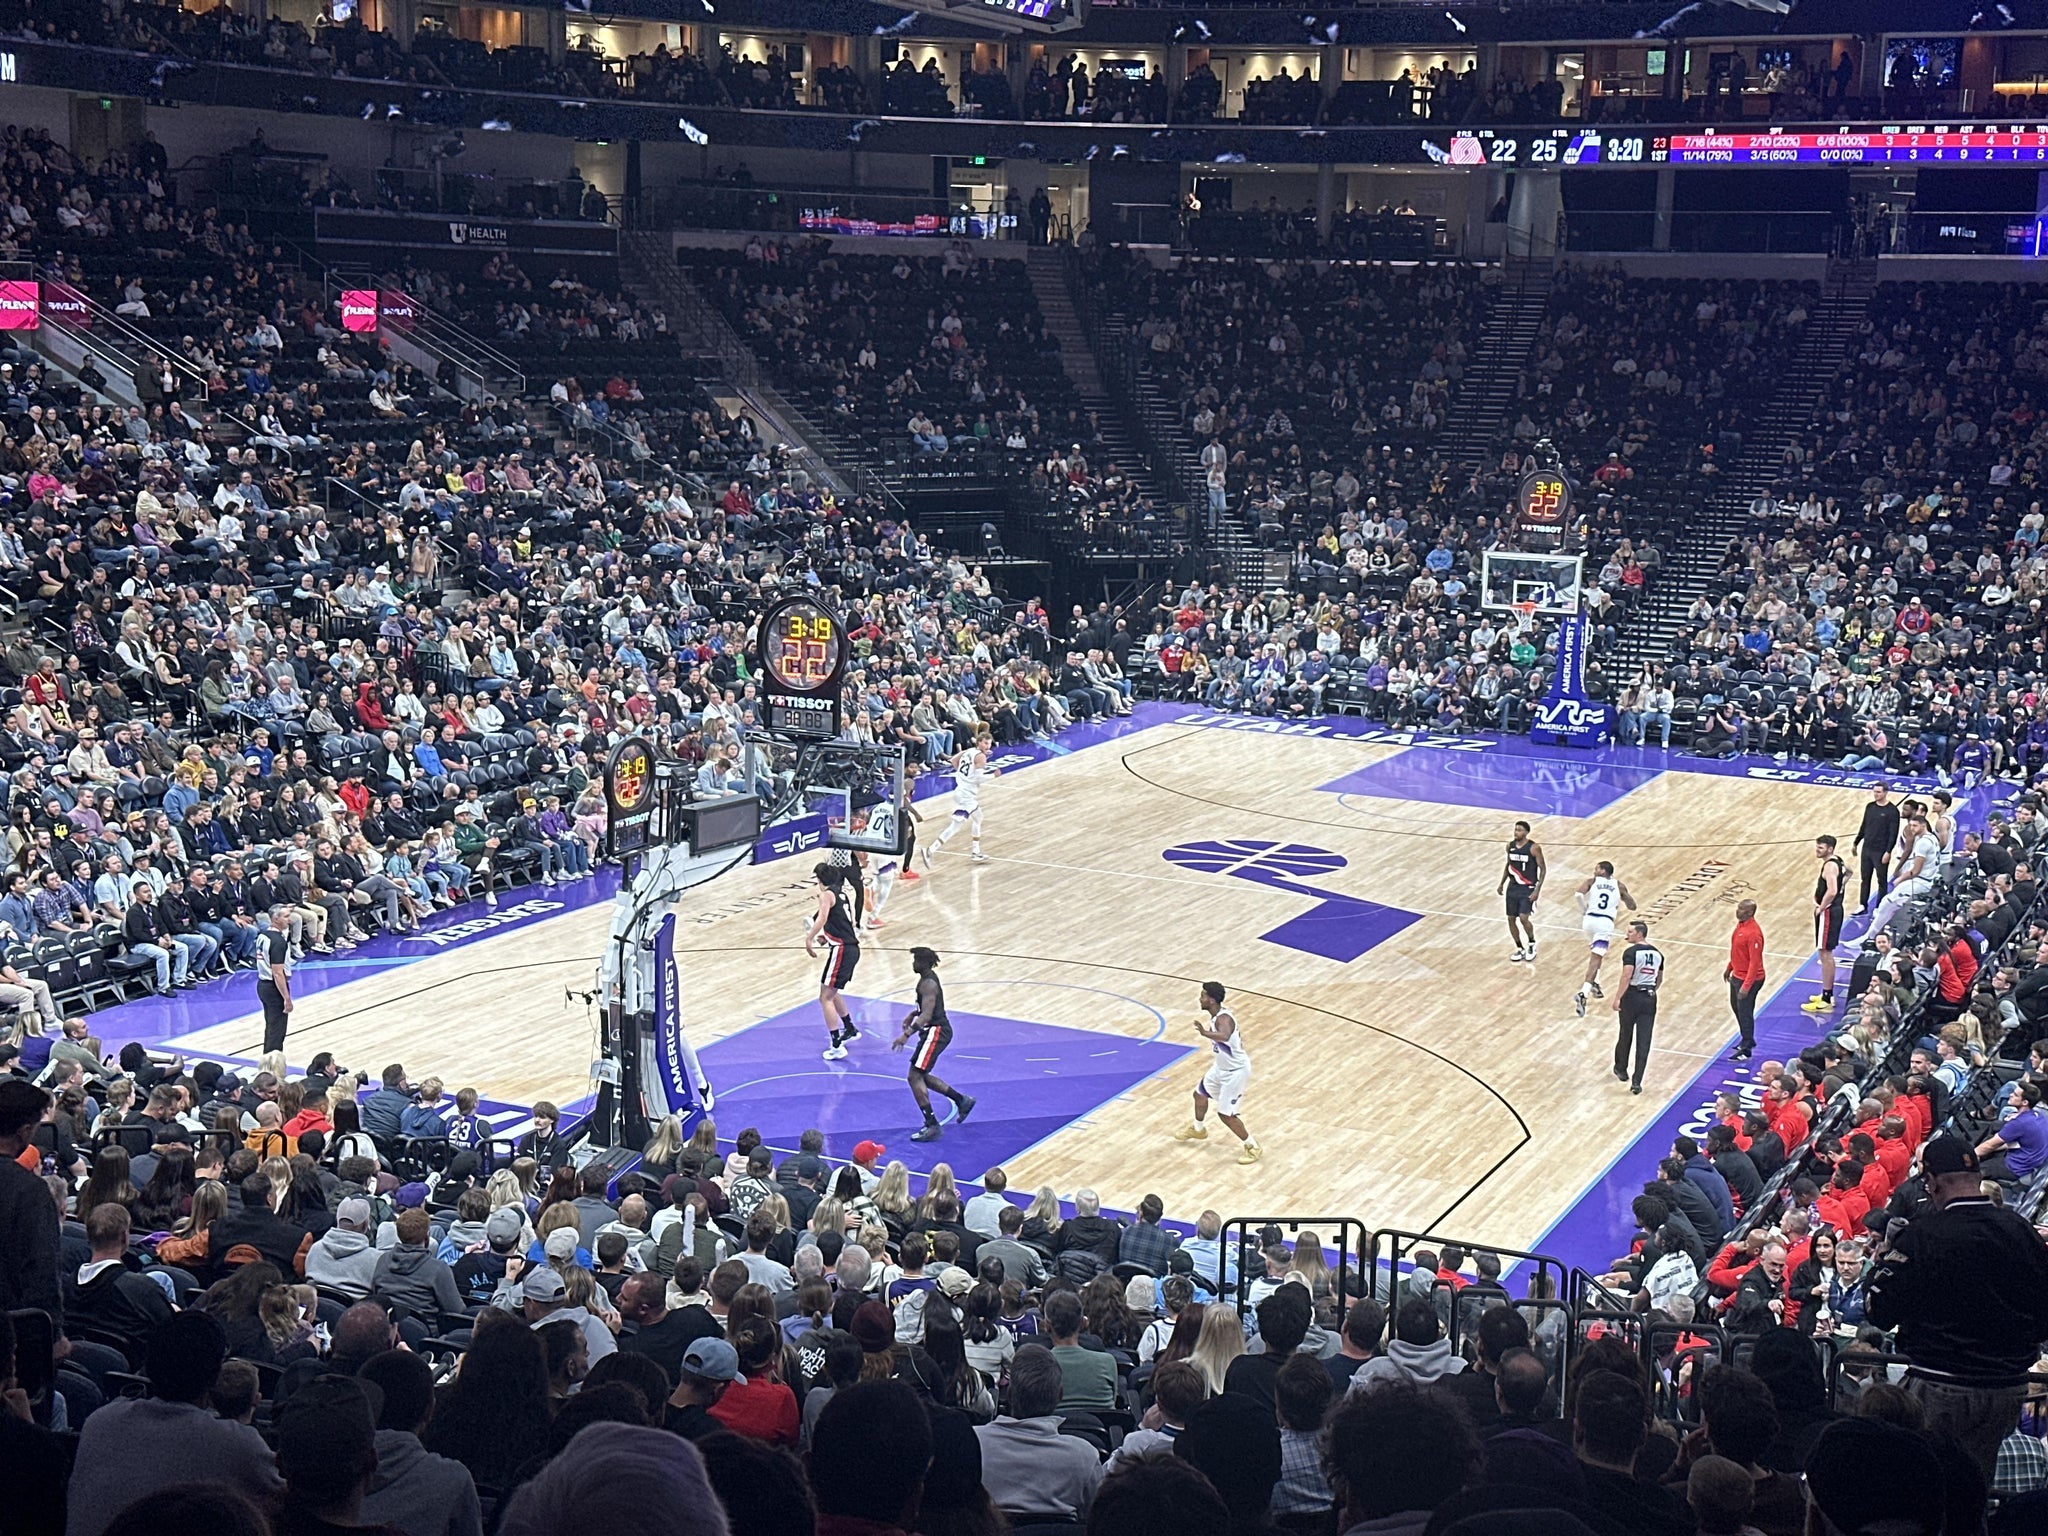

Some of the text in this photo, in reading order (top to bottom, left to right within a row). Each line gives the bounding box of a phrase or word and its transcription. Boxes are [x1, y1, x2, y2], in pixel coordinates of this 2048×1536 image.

[1959, 126, 1974, 134] AST
[1608, 138, 1643, 161] 3:20
[1653, 138, 1667, 148] 23
[1685, 138, 1705, 147] 7/16
[1706, 137, 1733, 148] (44%)
[1750, 137, 1771, 147] 2/10
[1773, 136, 1800, 147] (20%)
[1837, 136, 1870, 147] (100%)
[1886, 136, 1894, 146] 3
[1911, 136, 1918, 146] 2
[1936, 136, 1944, 146] 5
[1962, 136, 1969, 146] 5
[1986, 136, 1994, 145] 4
[2012, 136, 2020, 145] 0
[2038, 136, 2046, 145] 3
[1491, 140, 1517, 161] 22
[1531, 140, 1557, 161] 25
[1650, 150, 1667, 161] 1ST
[1682, 149, 2044, 162] 11/14 (79%) 3/5 (60%) 0/0 (0%) 1 3 4 9 2 1 5
[469, 228, 507, 239] HEALTH
[1536, 481, 1563, 496] 3:19
[1529, 494, 1558, 518] 22
[1533, 526, 1563, 534] TISSOT
[790, 616, 831, 640] 3:19
[782, 638, 827, 680] 22
[1562, 625, 1576, 694] AMERICA FIRST
[786, 695, 834, 711] TISSOT
[1173, 714, 1498, 752] UTAH JAZZ
[1535, 722, 1568, 731] AMERICA
[1568, 725, 1590, 734] FIRST
[960, 760, 970, 776] 23
[624, 812, 650, 826] TISSOT
[872, 816, 884, 830] 0
[1674, 867, 1724, 892] DELTA
[1598, 893, 1610, 910] 3
[403, 900, 565, 946] SEATGEEK
[1645, 953, 1654, 966] 14
[665, 958, 686, 1095] AMERICA FIRST
[449, 1120, 472, 1140] 23
